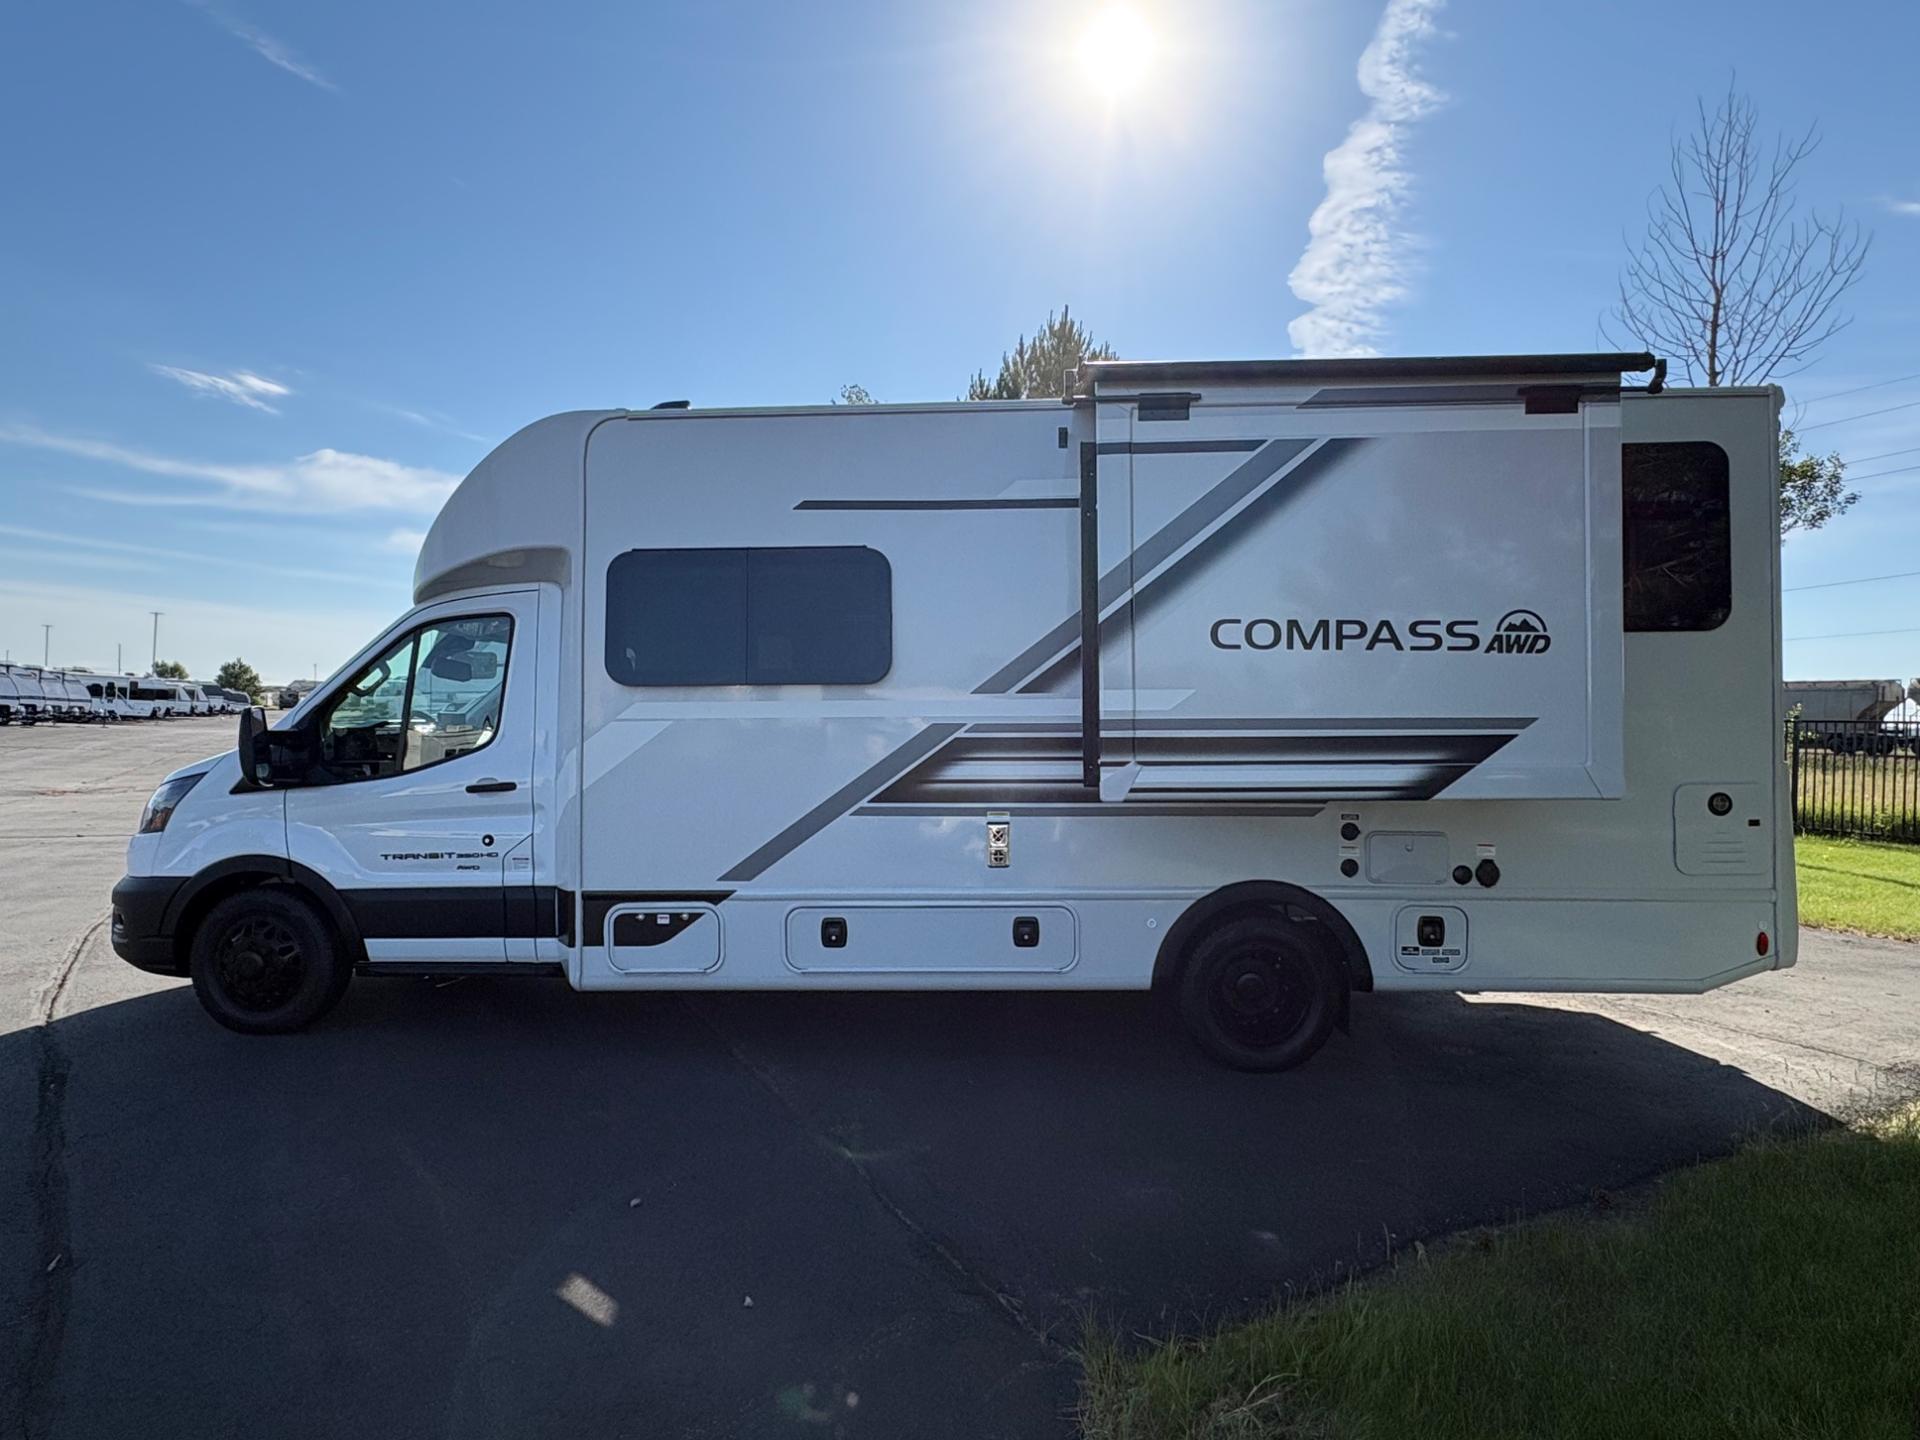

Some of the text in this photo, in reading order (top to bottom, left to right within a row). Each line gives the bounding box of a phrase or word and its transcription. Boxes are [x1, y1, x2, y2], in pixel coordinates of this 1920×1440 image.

[1210, 618, 1552, 655] COMPASS AWD
[380, 852, 456, 861] TRANSIT
